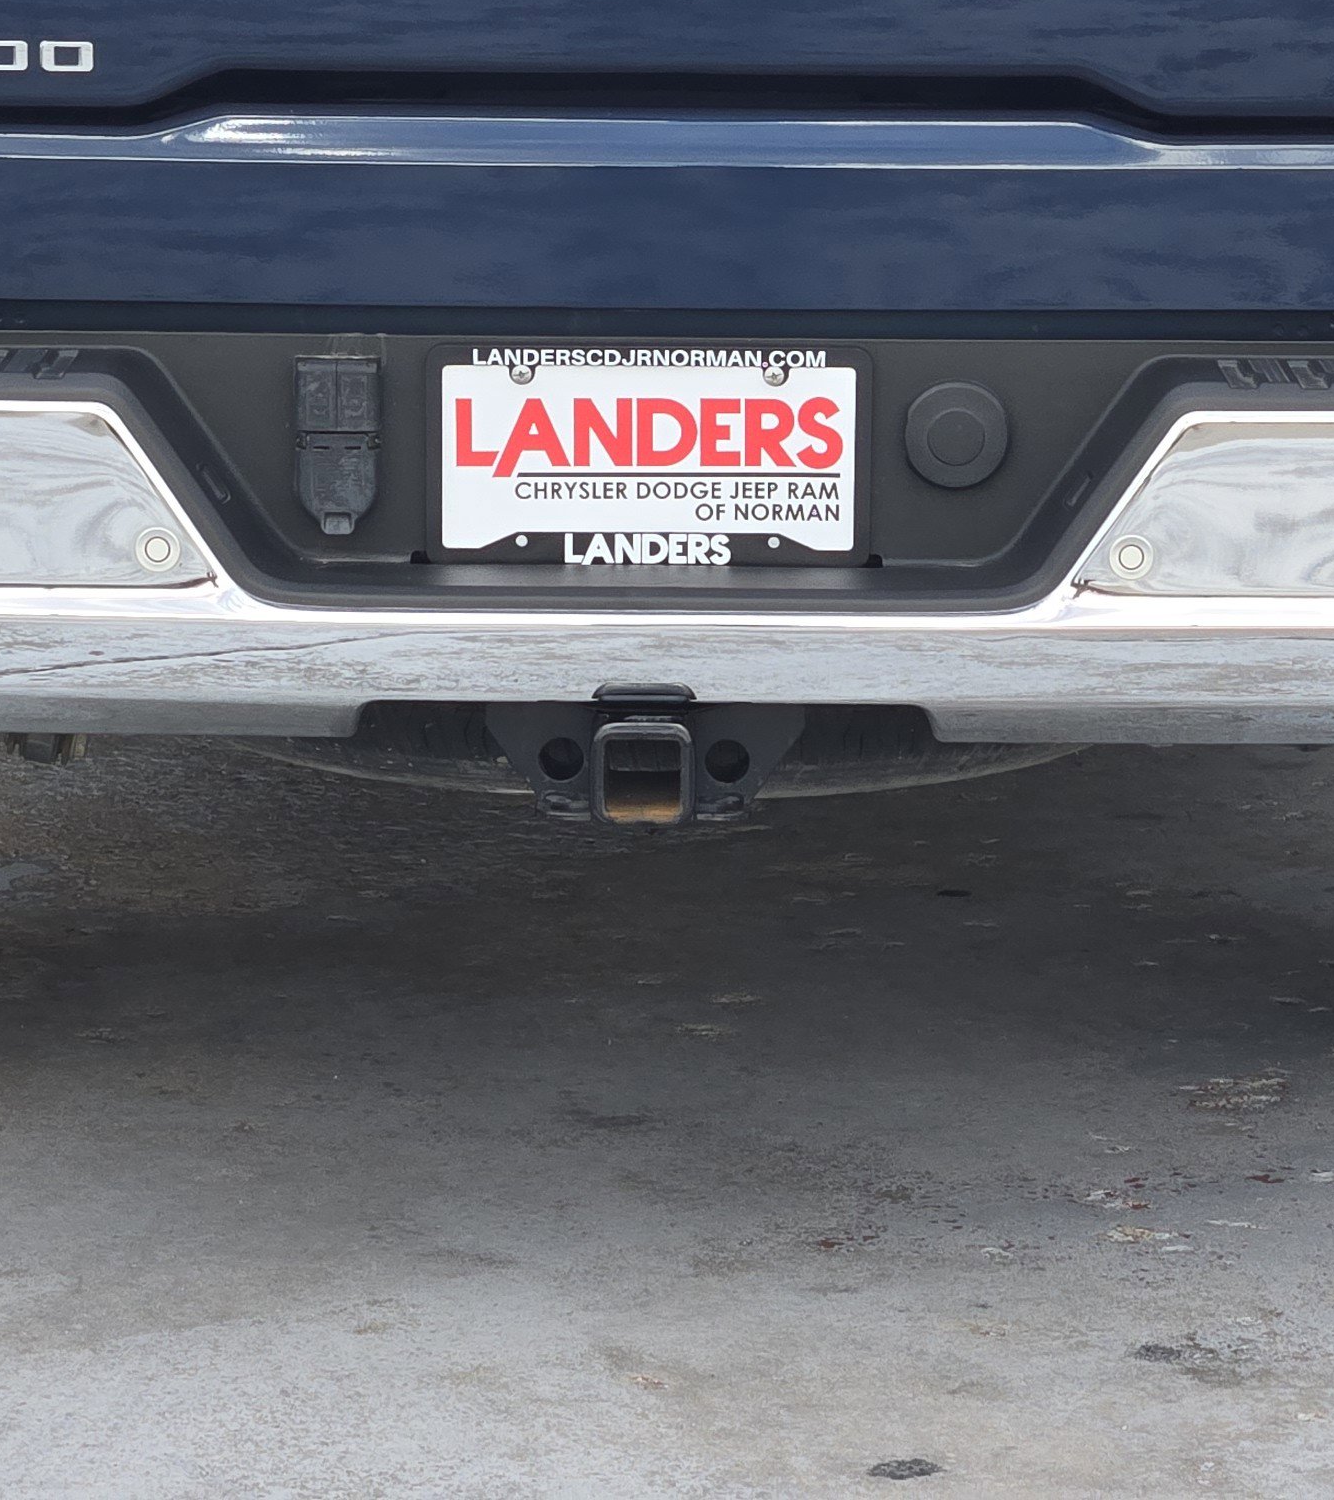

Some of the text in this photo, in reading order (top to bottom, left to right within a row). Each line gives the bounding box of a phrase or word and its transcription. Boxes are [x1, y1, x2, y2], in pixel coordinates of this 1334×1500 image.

[472, 348, 827, 369] LANDERSCDJRNORMAN.COM
[455, 397, 843, 478] LANDERS
[514, 482, 839, 500] CHRYSLER DODGE JEEP RAM
[695, 504, 841, 523] OF NORMAN
[564, 533, 731, 566] LANDERS
